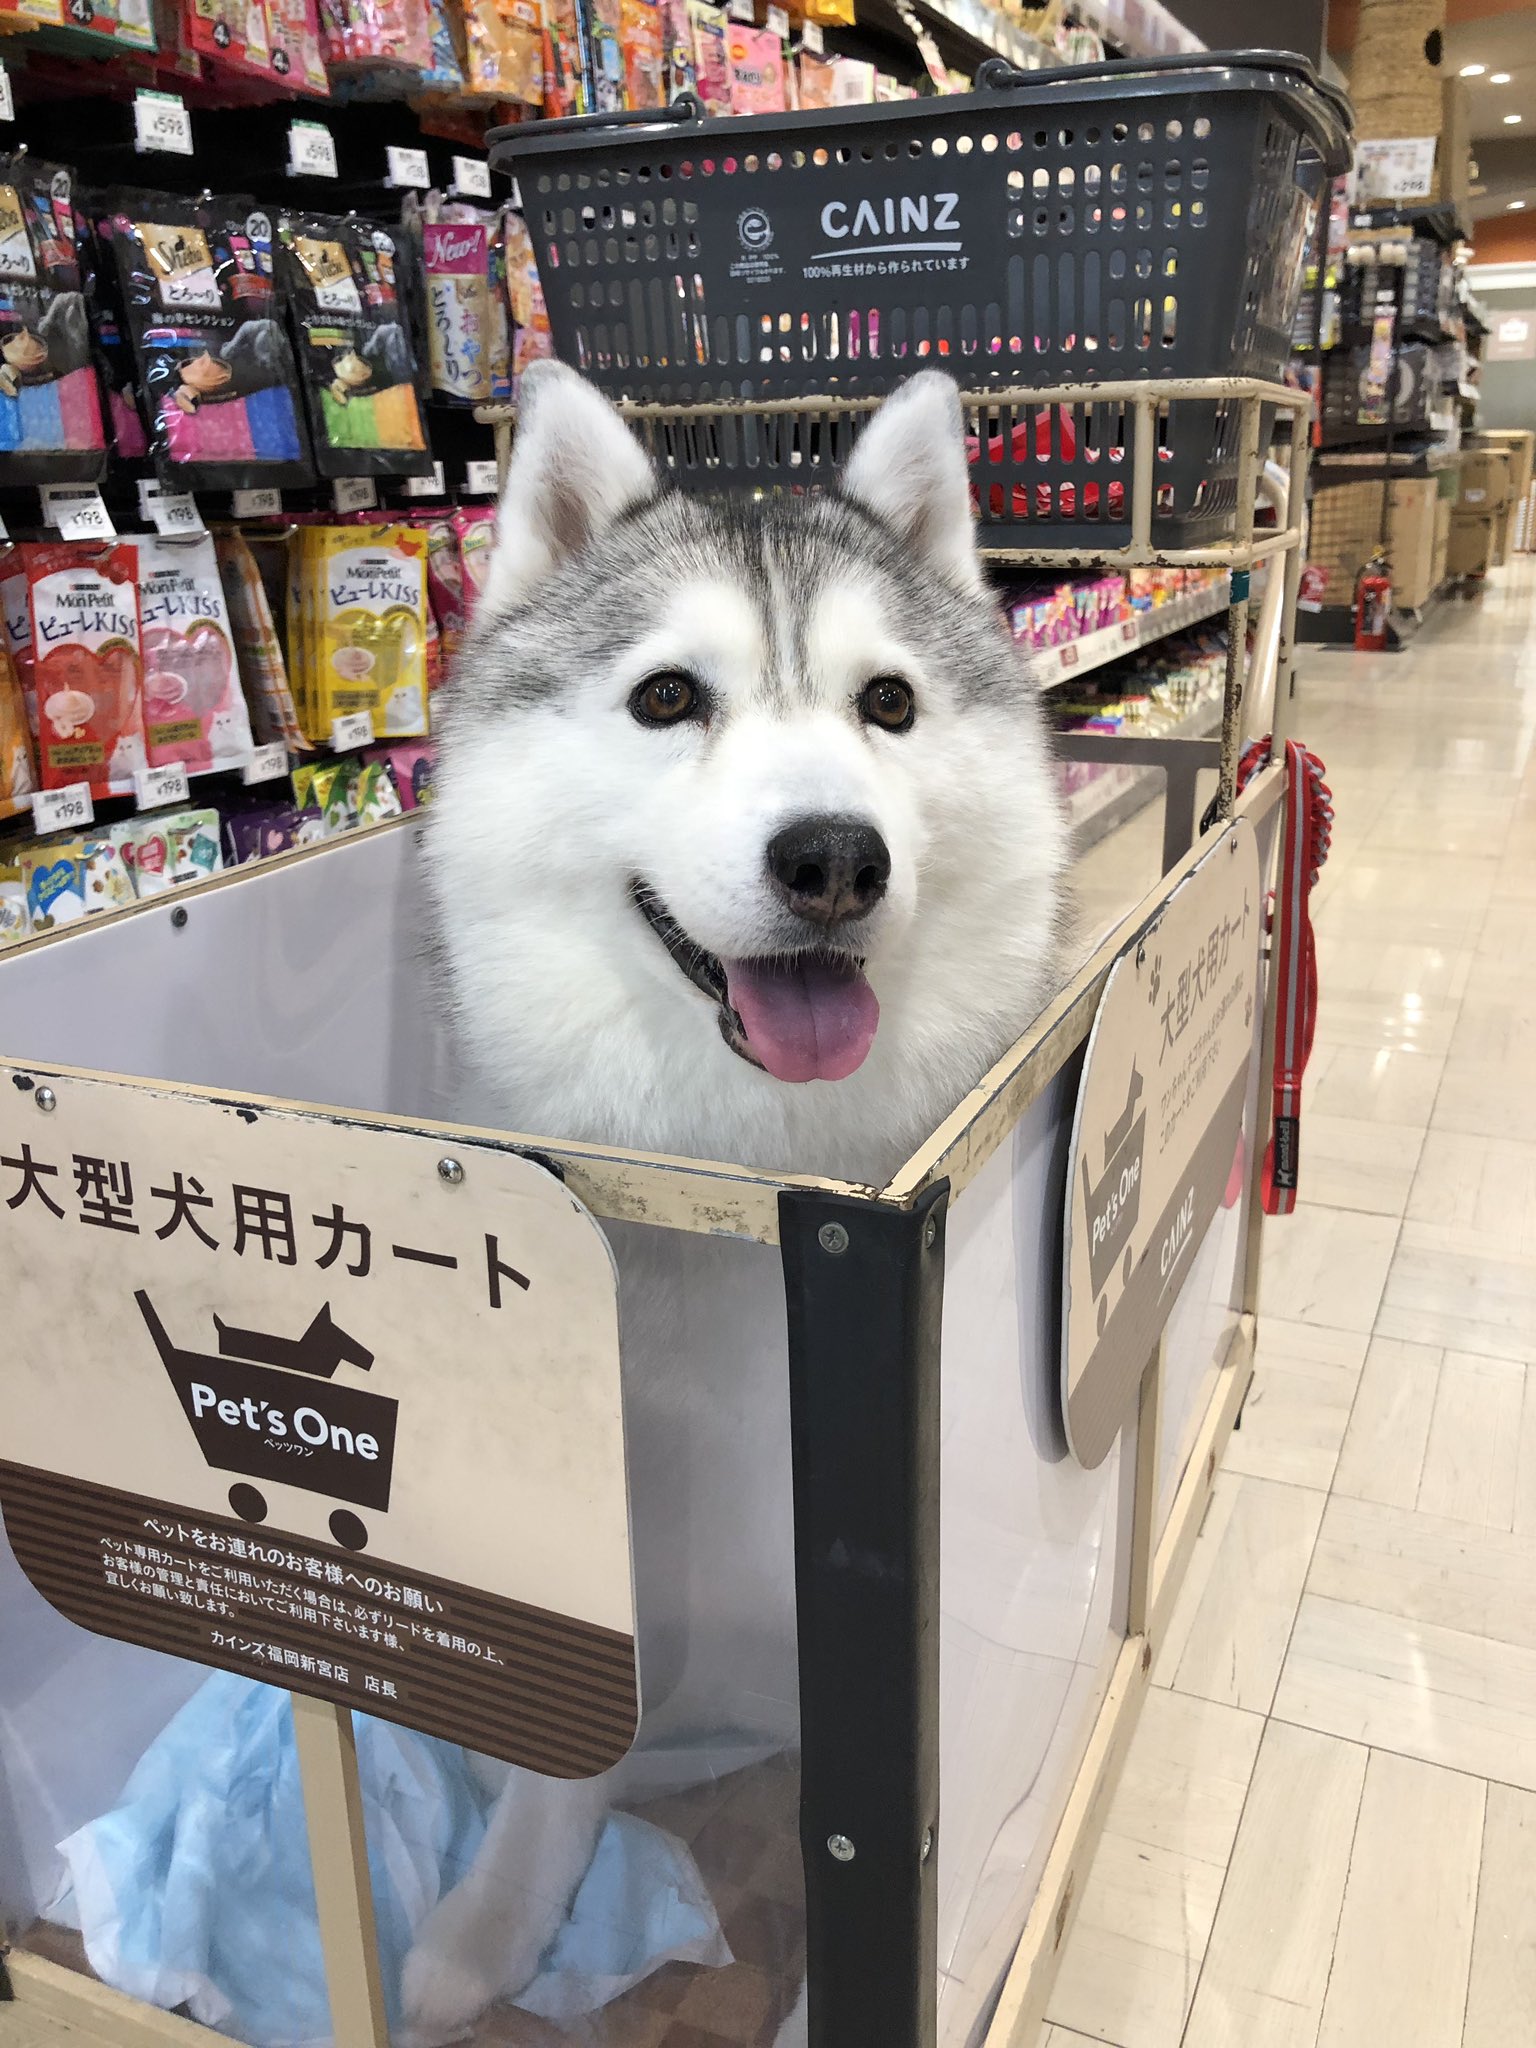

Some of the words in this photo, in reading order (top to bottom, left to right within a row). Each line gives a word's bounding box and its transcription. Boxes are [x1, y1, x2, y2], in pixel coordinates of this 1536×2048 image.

[250, 217, 269, 238] 20
[427, 228, 482, 269] New!
[820, 192, 961, 239] CAINZ
[802, 256, 970, 279] 100%再生材から作られています
[459, 308, 484, 386] おやつ
[55, 800, 84, 819] ¥198
[157, 779, 183, 796] ¥198
[1158, 887, 1250, 1068] 大型犬用カート
[0, 1142, 532, 1309] 大型犬用カート
[1092, 1191, 1119, 1258] Pet's
[1119, 1155, 1141, 1207] One
[1160, 1185, 1195, 1277] CAINZ
[190, 1381, 289, 1437] Pet's
[293, 1406, 381, 1461] One
[263, 1437, 315, 1458] ペッツワン
[99, 1536, 506, 1666] ペット専用カートをご利用いただく場合は、必ずリードを着用の上、
[102, 1552, 406, 1653] お客様の管理と責任においてご利用下さいます様、
[104, 1569, 236, 1619] 宜しくお願い致します。
[143, 1518, 445, 1614] ペットをお連れのお客様へのお願い
[210, 1630, 351, 1684] カインズ福岡新宮店
[364, 1674, 399, 1700] 店長
